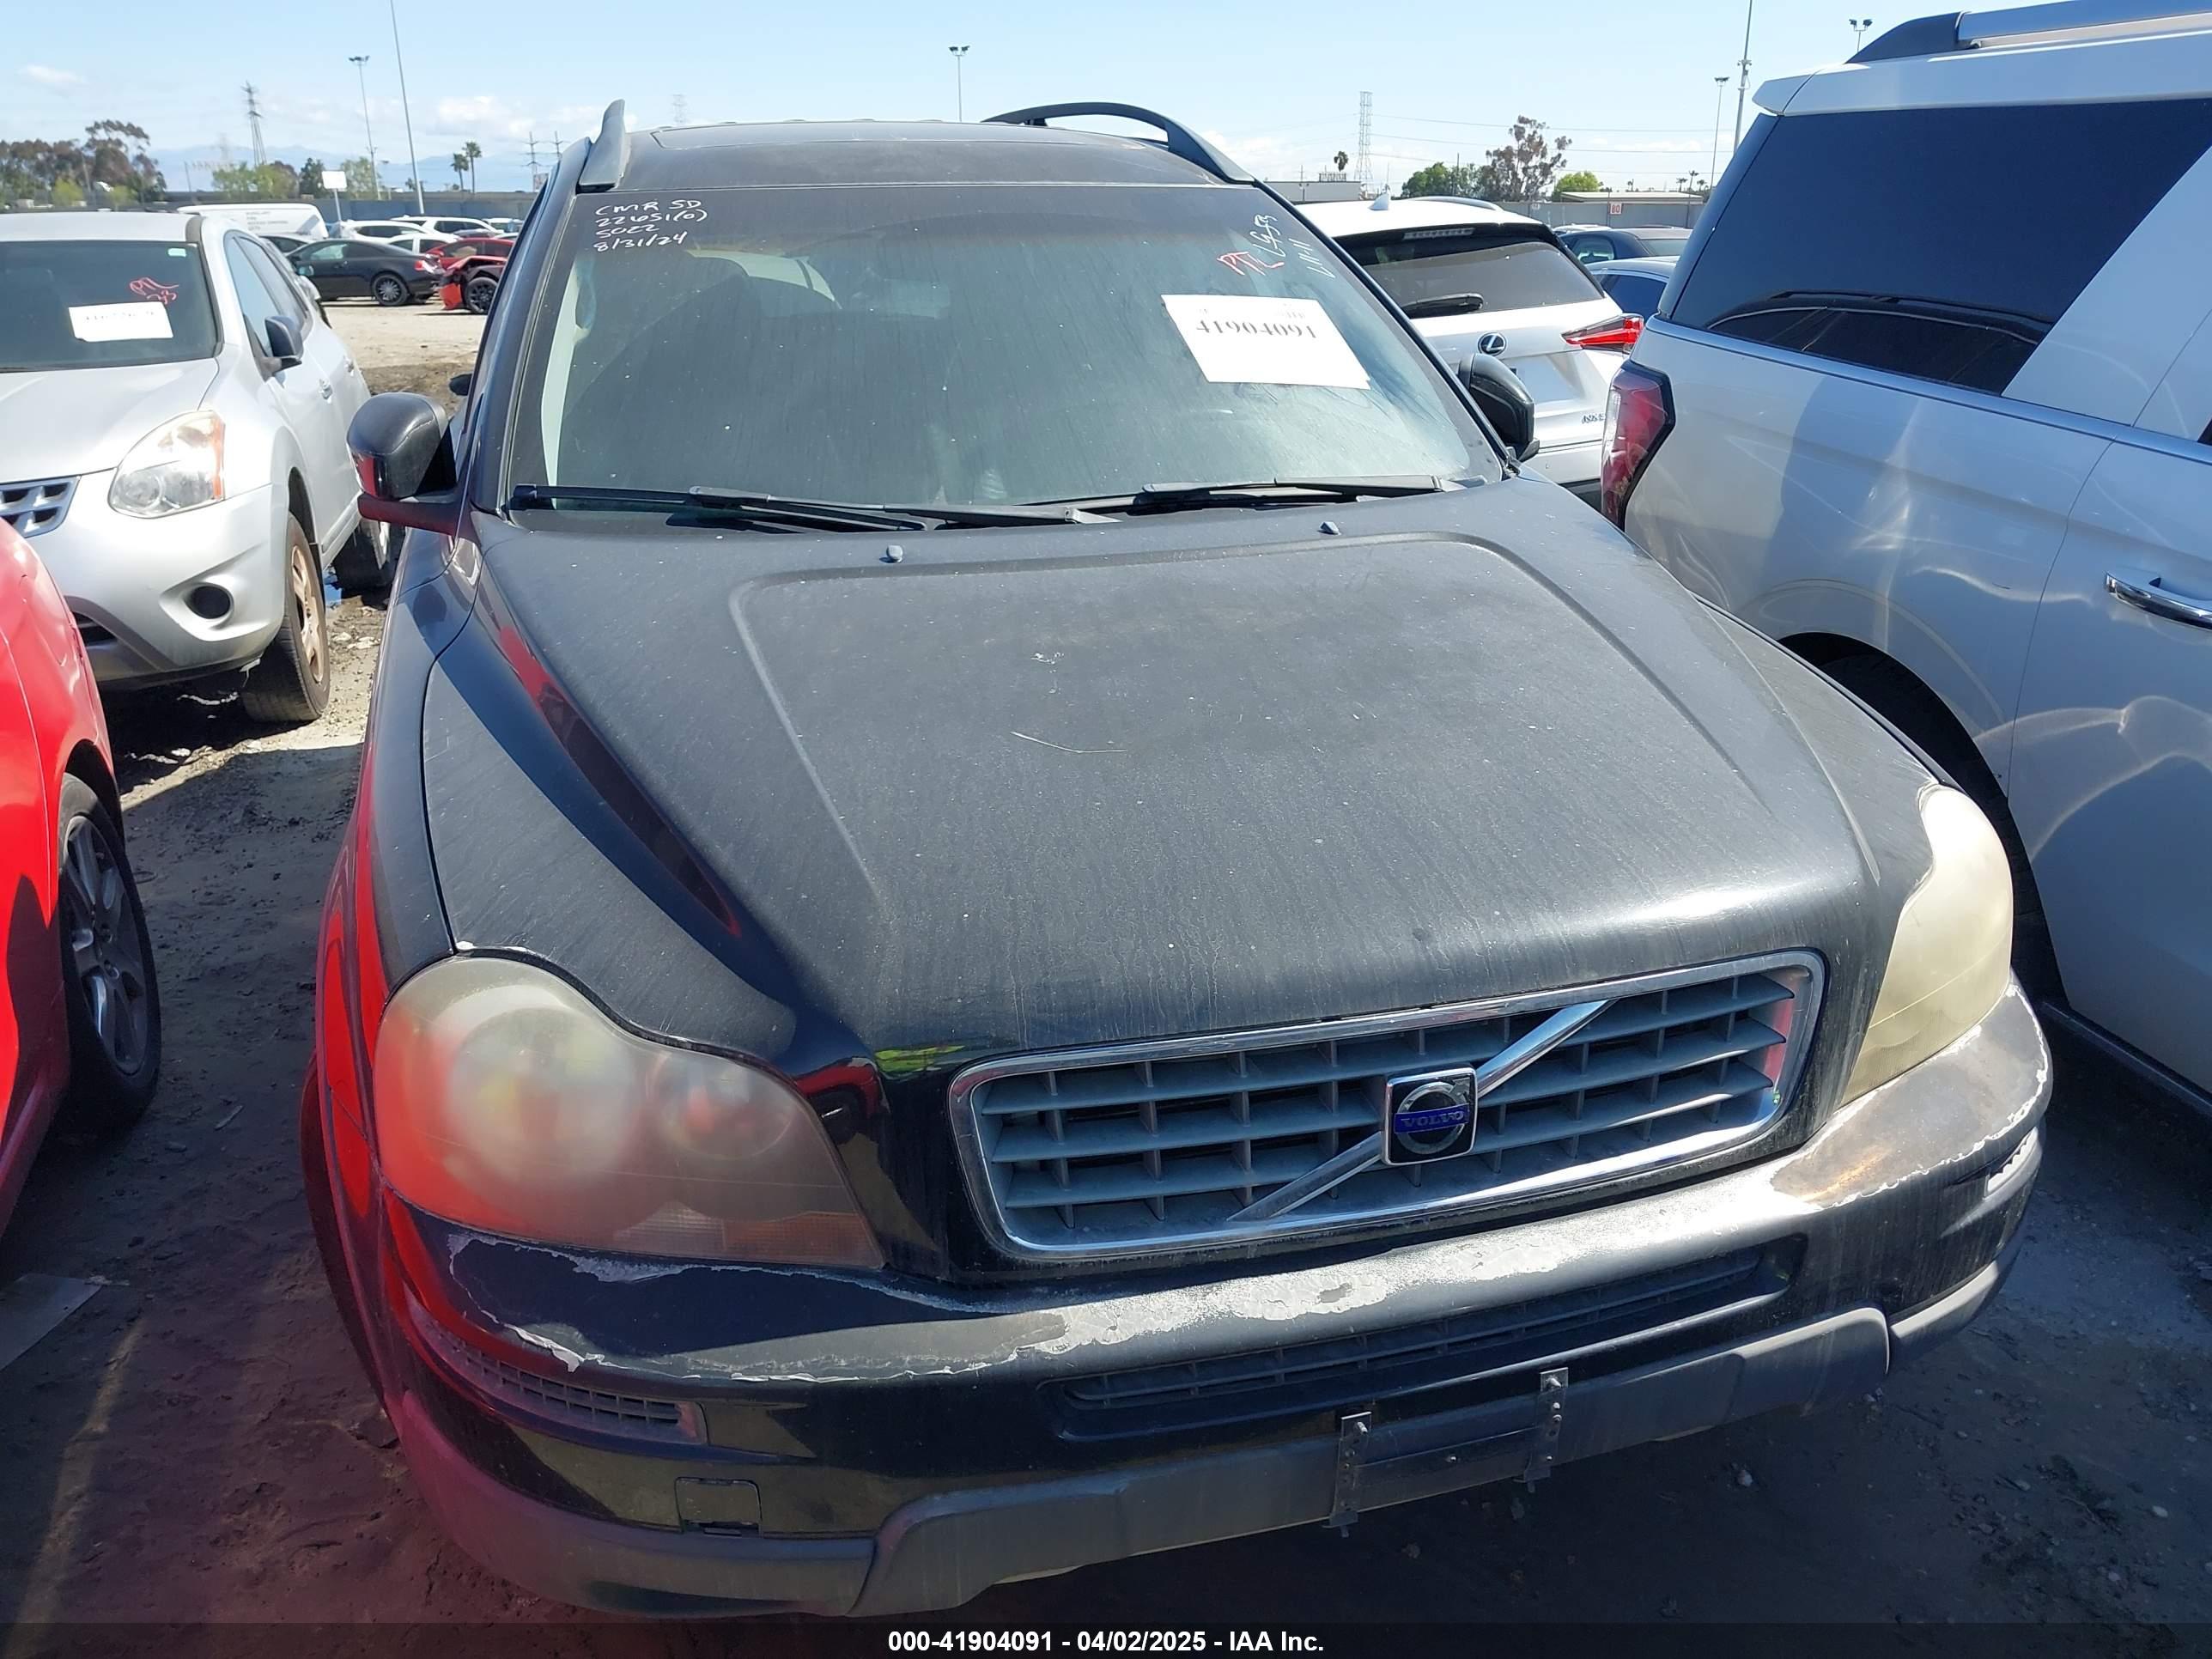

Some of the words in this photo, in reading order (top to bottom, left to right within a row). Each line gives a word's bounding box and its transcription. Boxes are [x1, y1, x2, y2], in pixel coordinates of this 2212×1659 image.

[669, 199, 702, 210] SD
[592, 231, 688, 252] 8/31/24
[1195, 319, 1316, 338] 41904091
[1400, 1110, 1465, 1127] VOLVO
